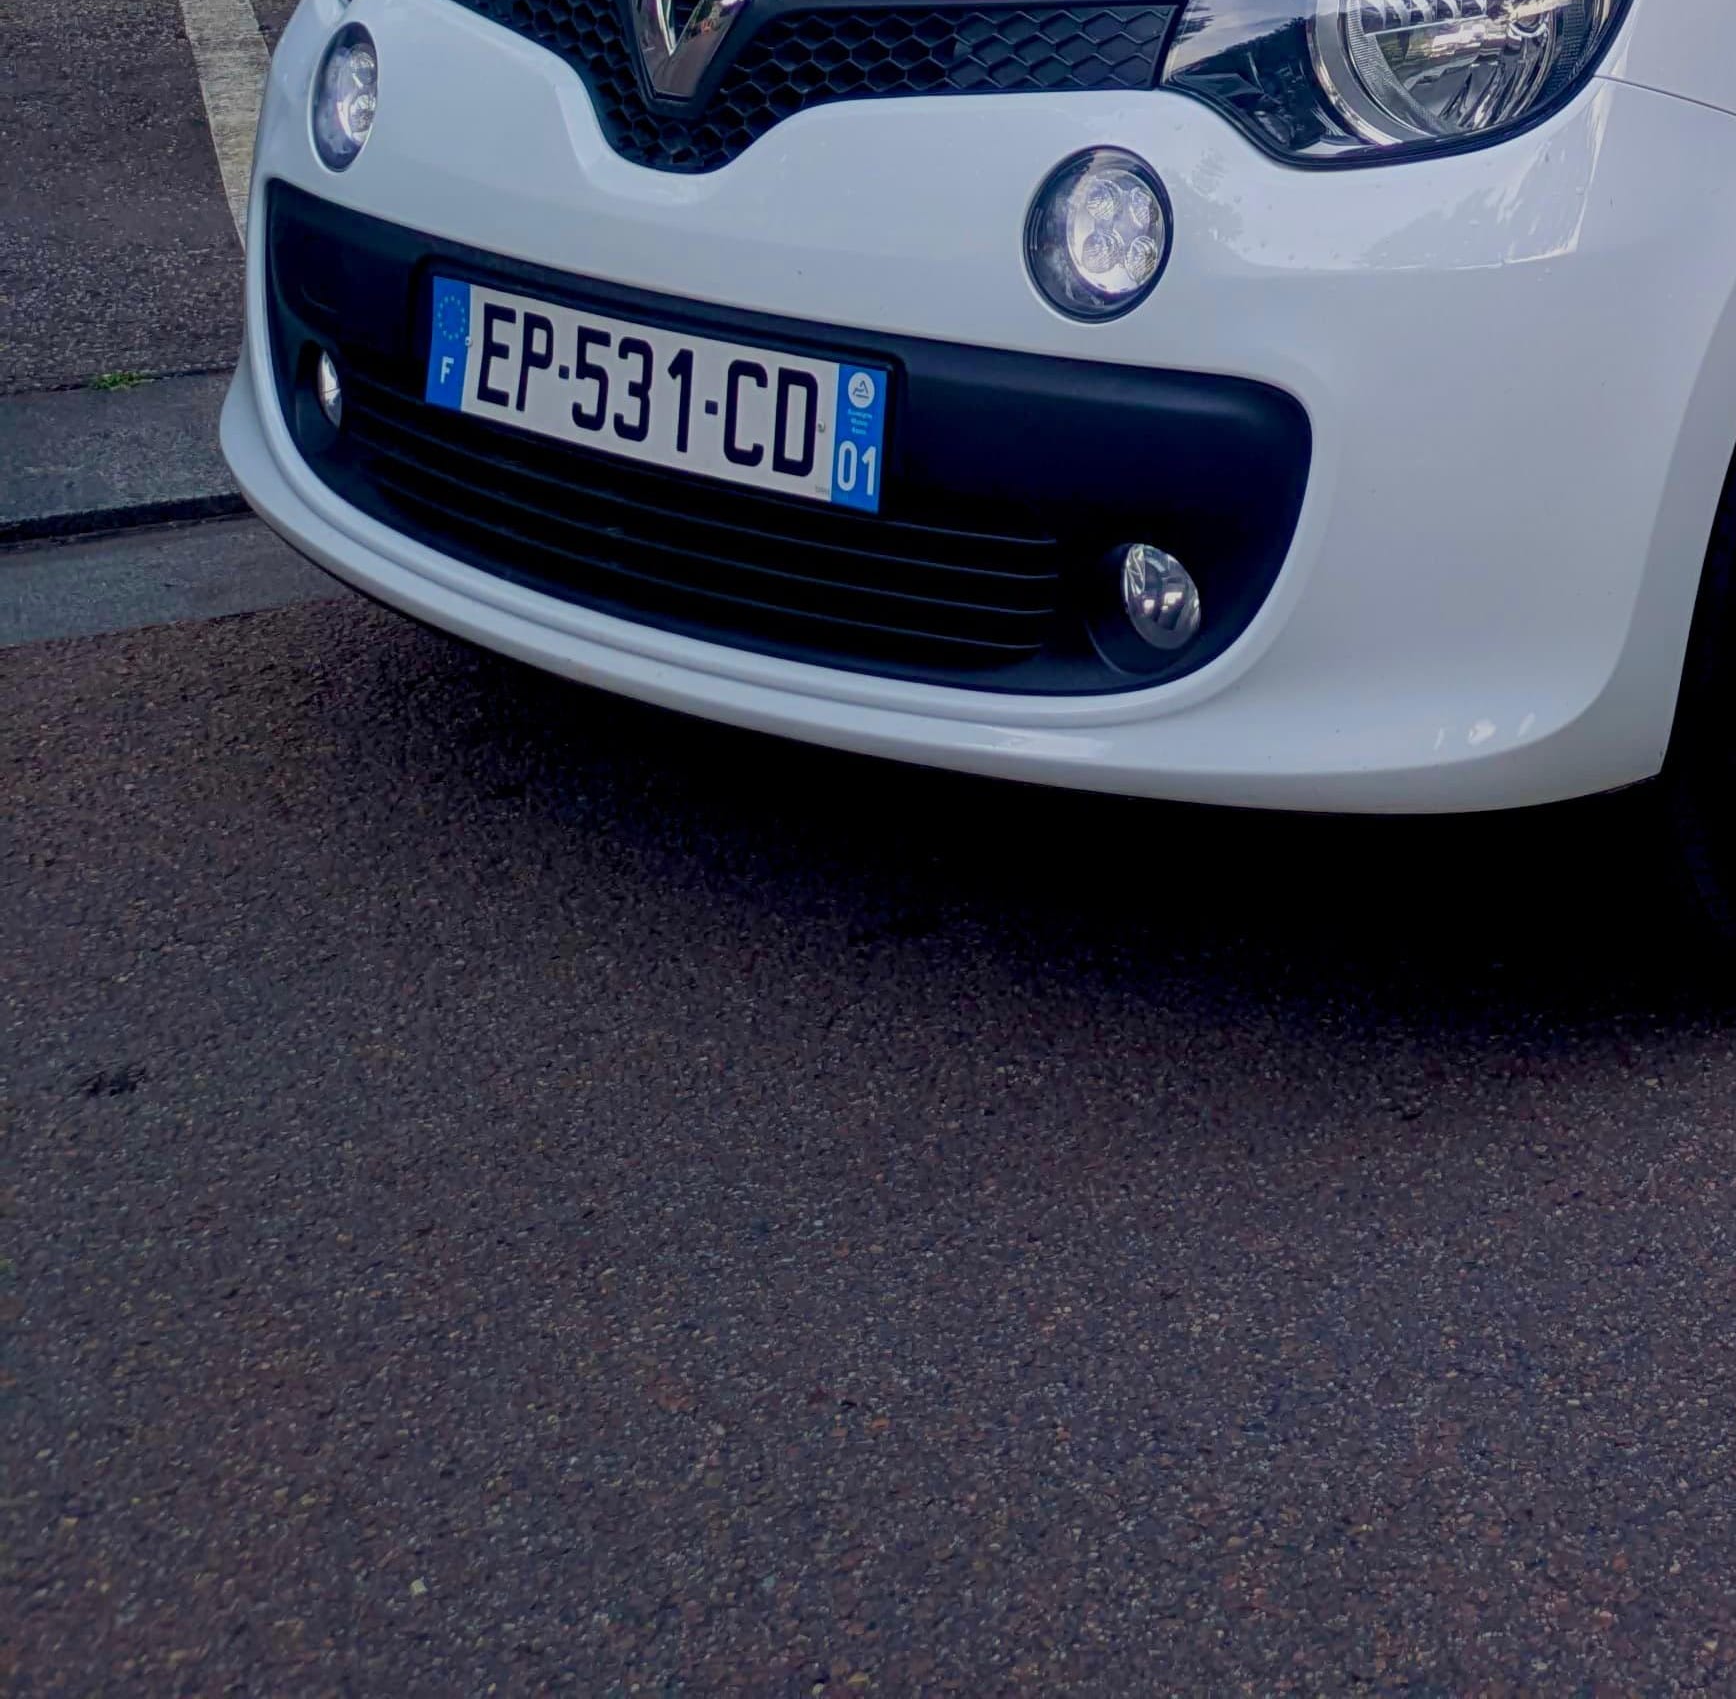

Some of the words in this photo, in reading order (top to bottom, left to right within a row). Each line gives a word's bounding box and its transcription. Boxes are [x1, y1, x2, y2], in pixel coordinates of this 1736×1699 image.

[440, 356, 454, 384] F
[477, 303, 818, 477] EP-531-CD
[837, 440, 876, 496] 01
